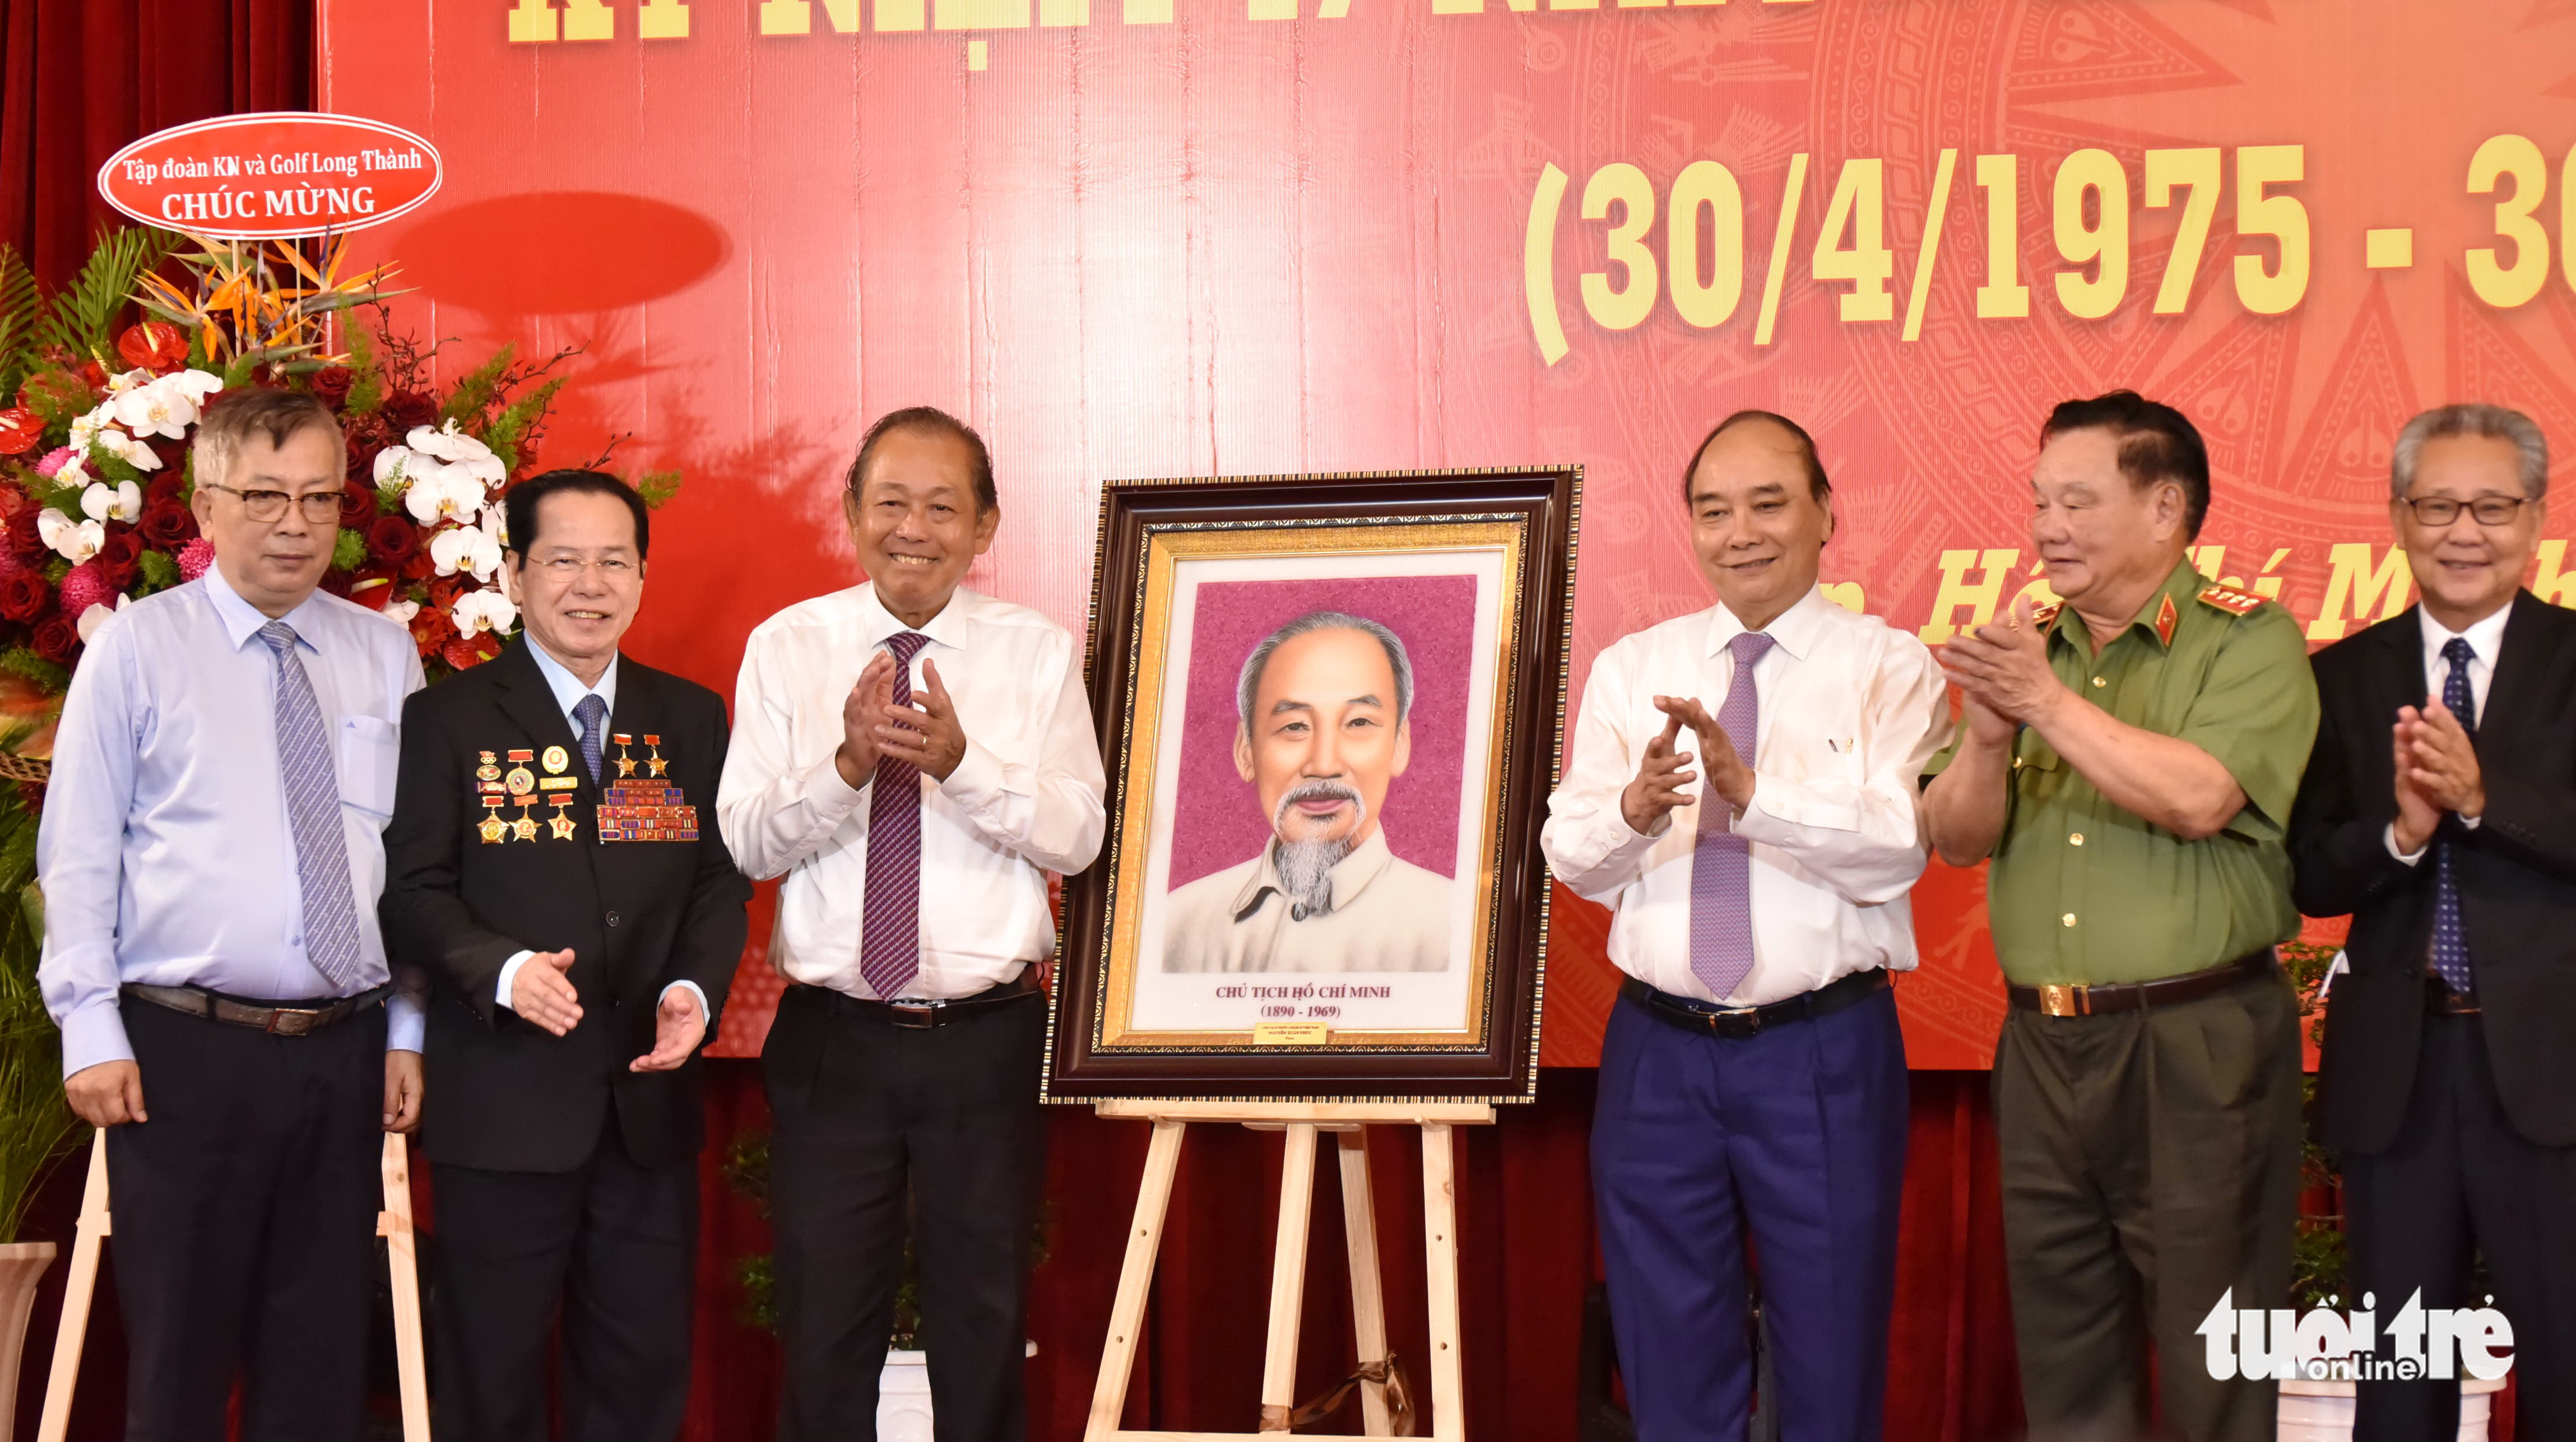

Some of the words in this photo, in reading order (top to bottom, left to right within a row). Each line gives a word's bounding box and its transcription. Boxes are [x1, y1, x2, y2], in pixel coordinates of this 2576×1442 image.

[123, 158, 157, 185] Tập
[162, 157, 208, 178] đoàn
[213, 156, 240, 176] KN
[244, 154, 266, 175] và
[270, 153, 309, 174] Golf
[312, 153, 358, 177] Long
[362, 148, 422, 170] Thành
[162, 185, 255, 220] CHÚC
[264, 182, 375, 216] MỪNG
[1524, 146, 2310, 368] (30/4/1975
[2466, 134, 2576, 308] 3
[1216, 982, 1248, 998] CHỦ
[1252, 986, 1288, 1001] TỊCH
[1318, 984, 1346, 998] CHÍ
[1350, 986, 1391, 998] MINH
[1260, 1005, 1295, 1018] (1890
[1307, 1005, 1341, 1018] 1969)
